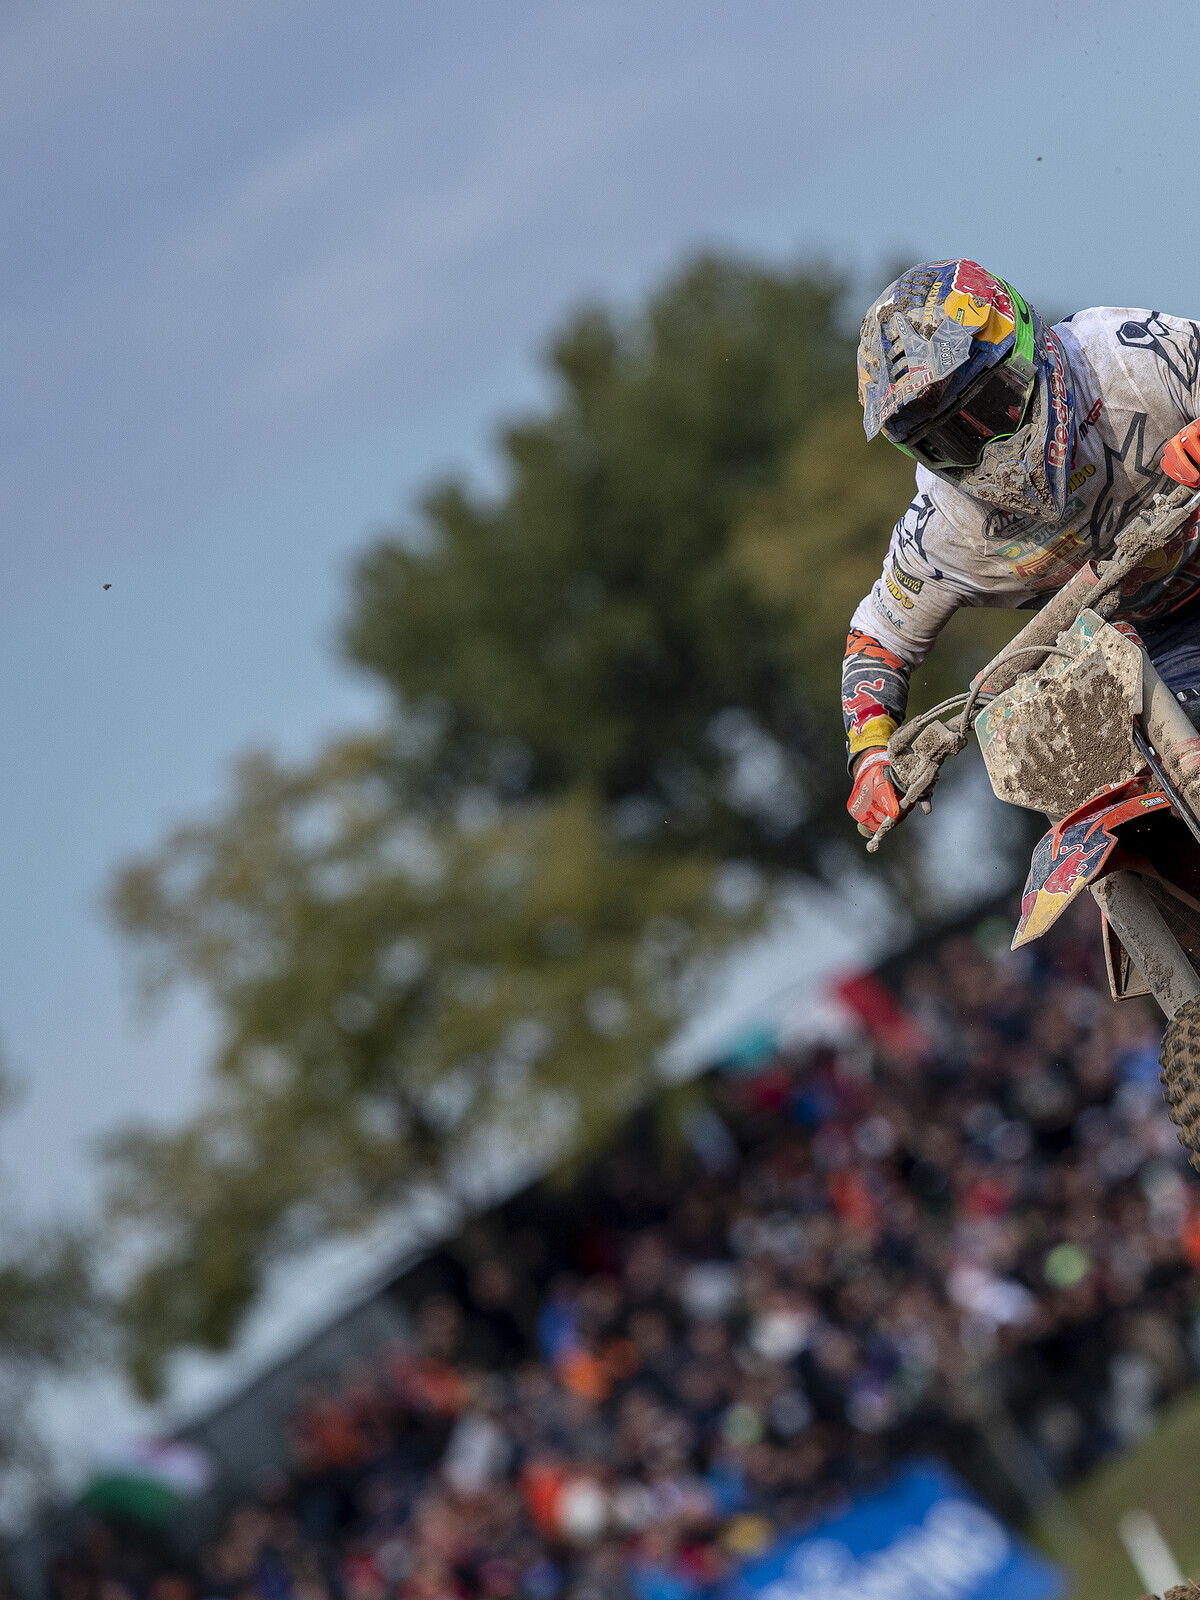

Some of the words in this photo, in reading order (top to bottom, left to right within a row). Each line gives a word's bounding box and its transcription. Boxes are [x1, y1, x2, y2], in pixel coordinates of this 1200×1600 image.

[902, 371, 934, 397] Bull
[1048, 400, 1069, 469] Red
[1078, 398, 1104, 441] MXGP
[1015, 533, 1079, 577] PIRELLI
